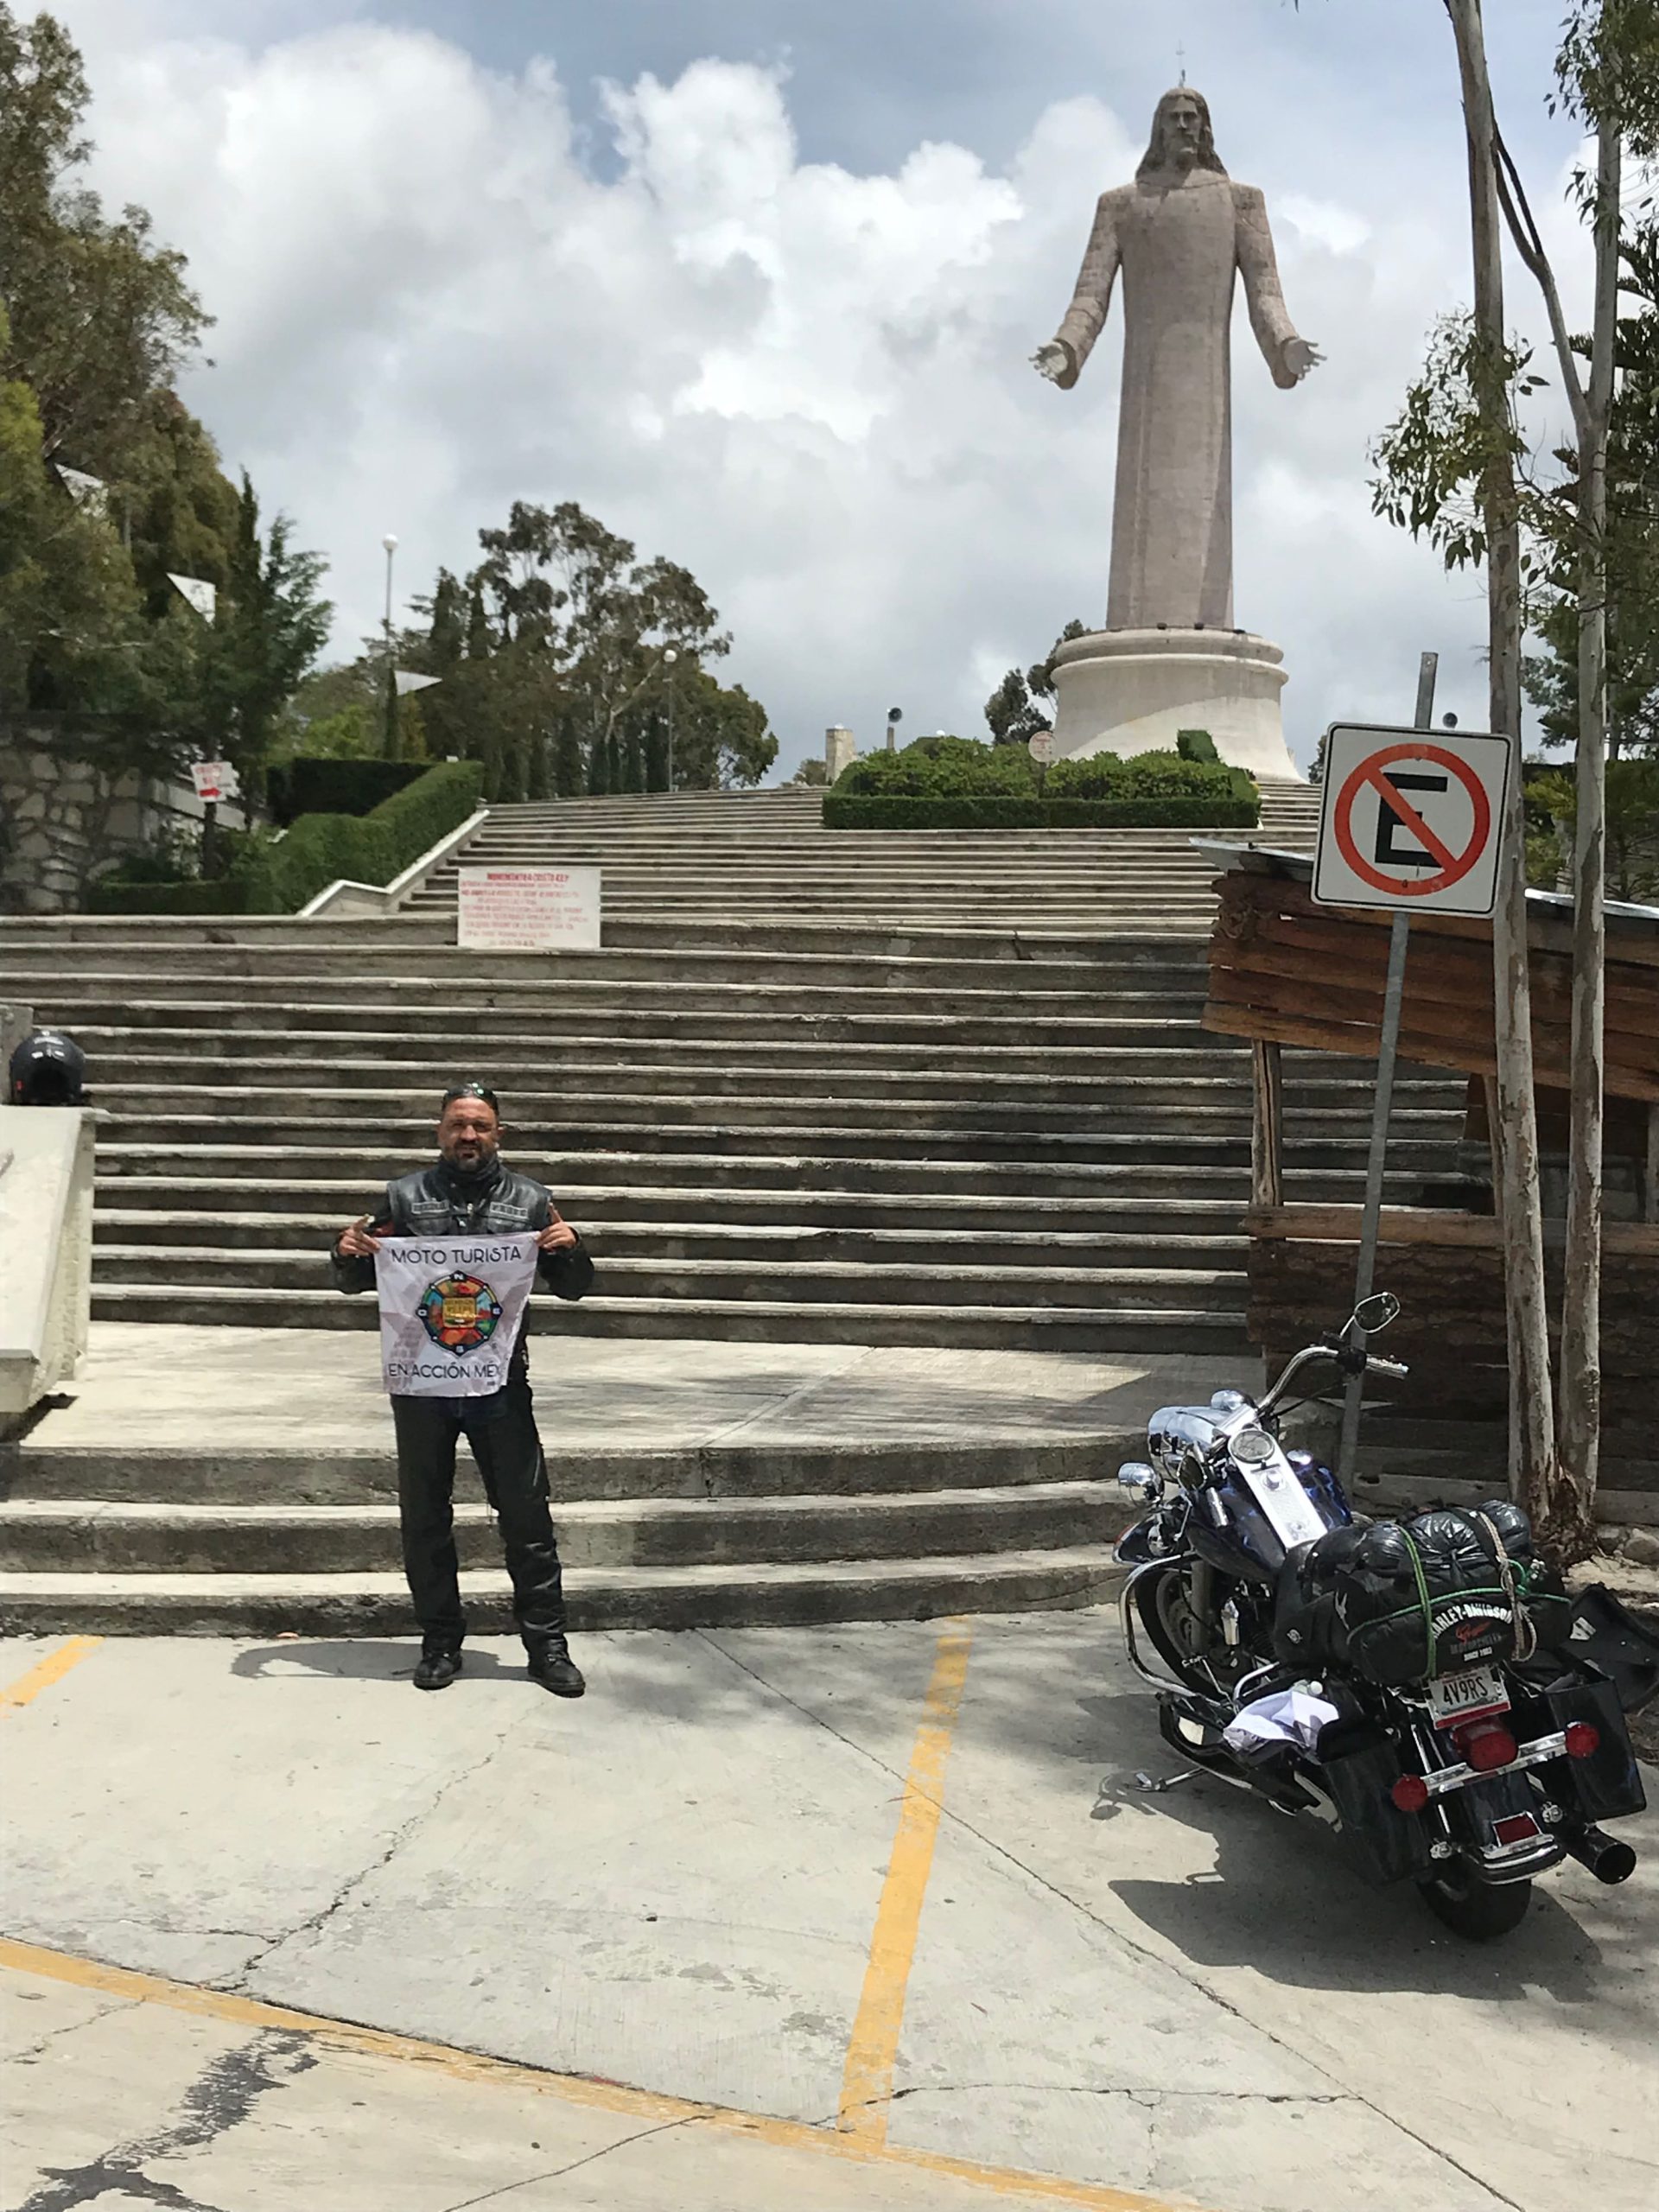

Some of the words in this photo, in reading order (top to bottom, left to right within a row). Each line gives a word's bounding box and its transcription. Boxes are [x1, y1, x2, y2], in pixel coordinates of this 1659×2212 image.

[391, 1249, 447, 1264] MOTO
[452, 1246, 522, 1263] TURISTA
[389, 1363, 408, 1376] EN
[411, 1362, 470, 1379] ACCIÓN
[1443, 1676, 1488, 1706] 4V9RS
